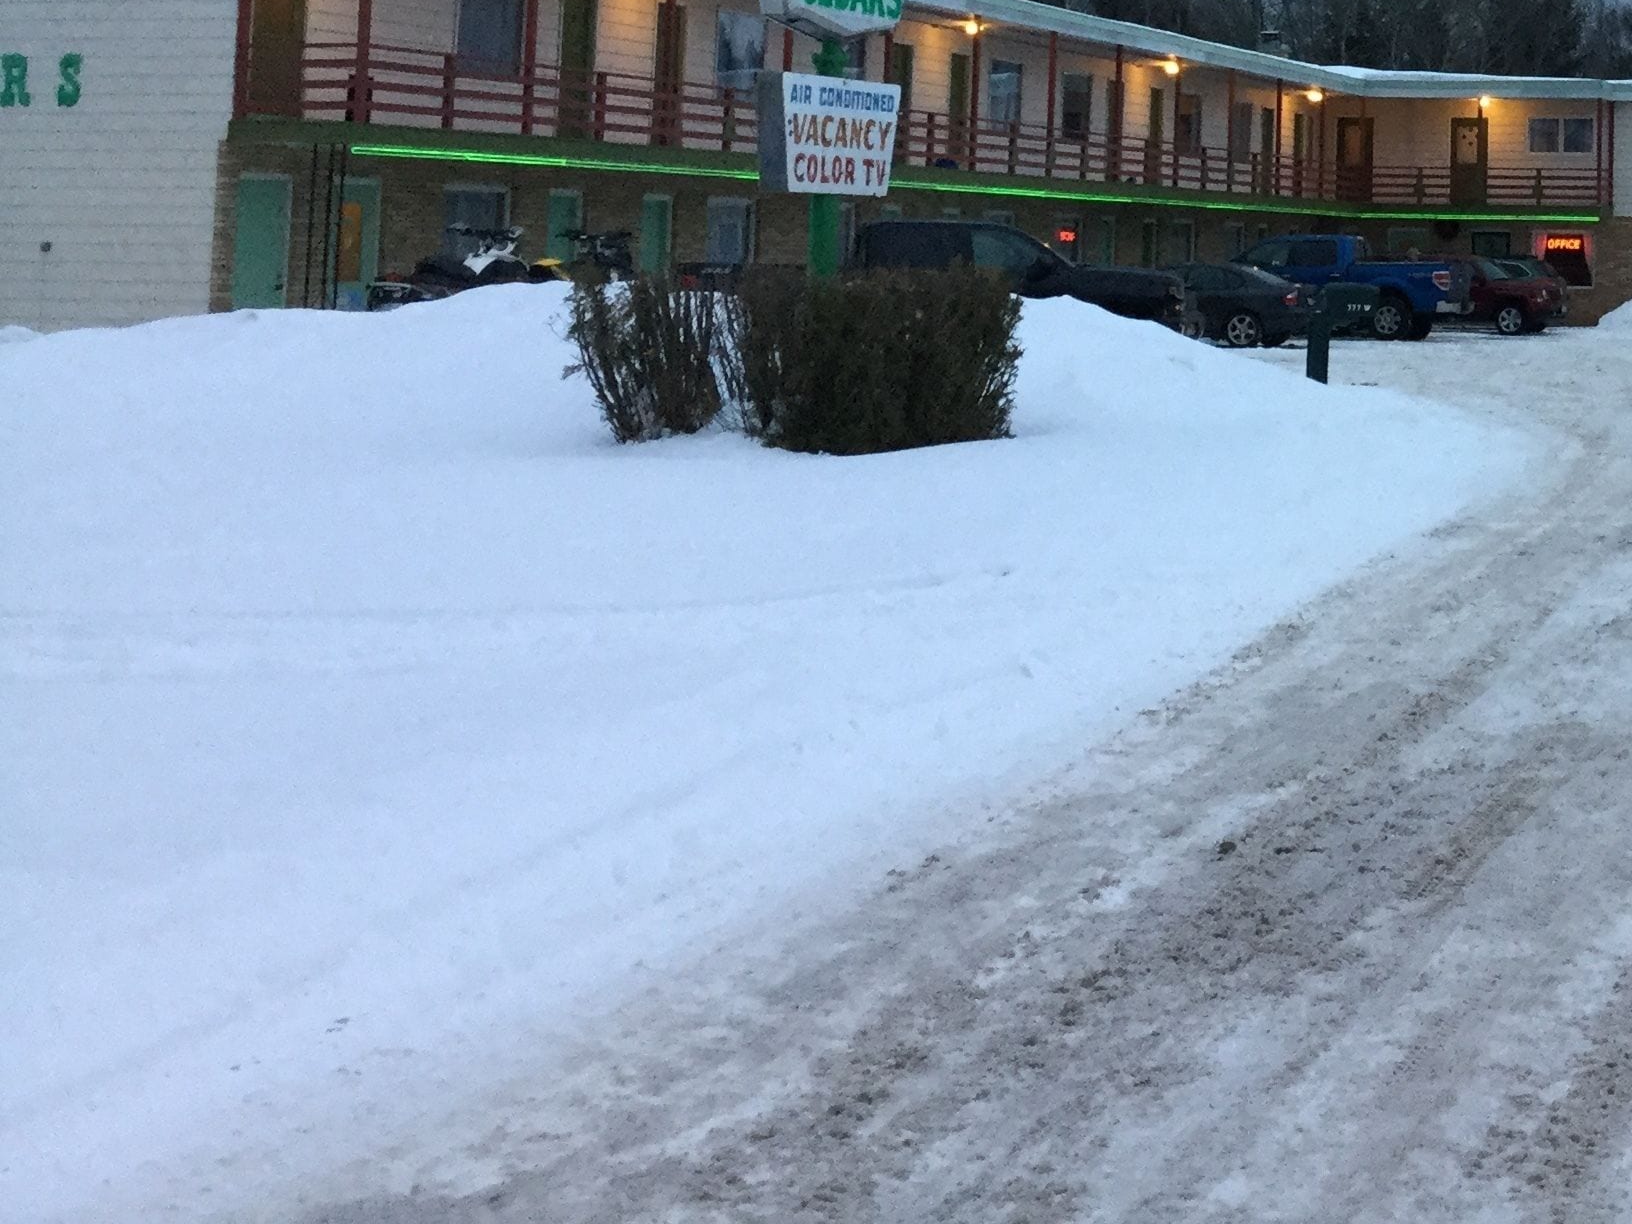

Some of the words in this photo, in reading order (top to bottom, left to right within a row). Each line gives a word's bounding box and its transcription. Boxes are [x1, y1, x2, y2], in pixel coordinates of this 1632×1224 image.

[790, 84, 812, 105] AIR
[819, 87, 895, 113] CONDITIONED
[793, 113, 893, 151] VACANCY
[794, 153, 856, 185] COLOR
[863, 158, 886, 186] TV
[1547, 238, 1581, 249] OFFICE
